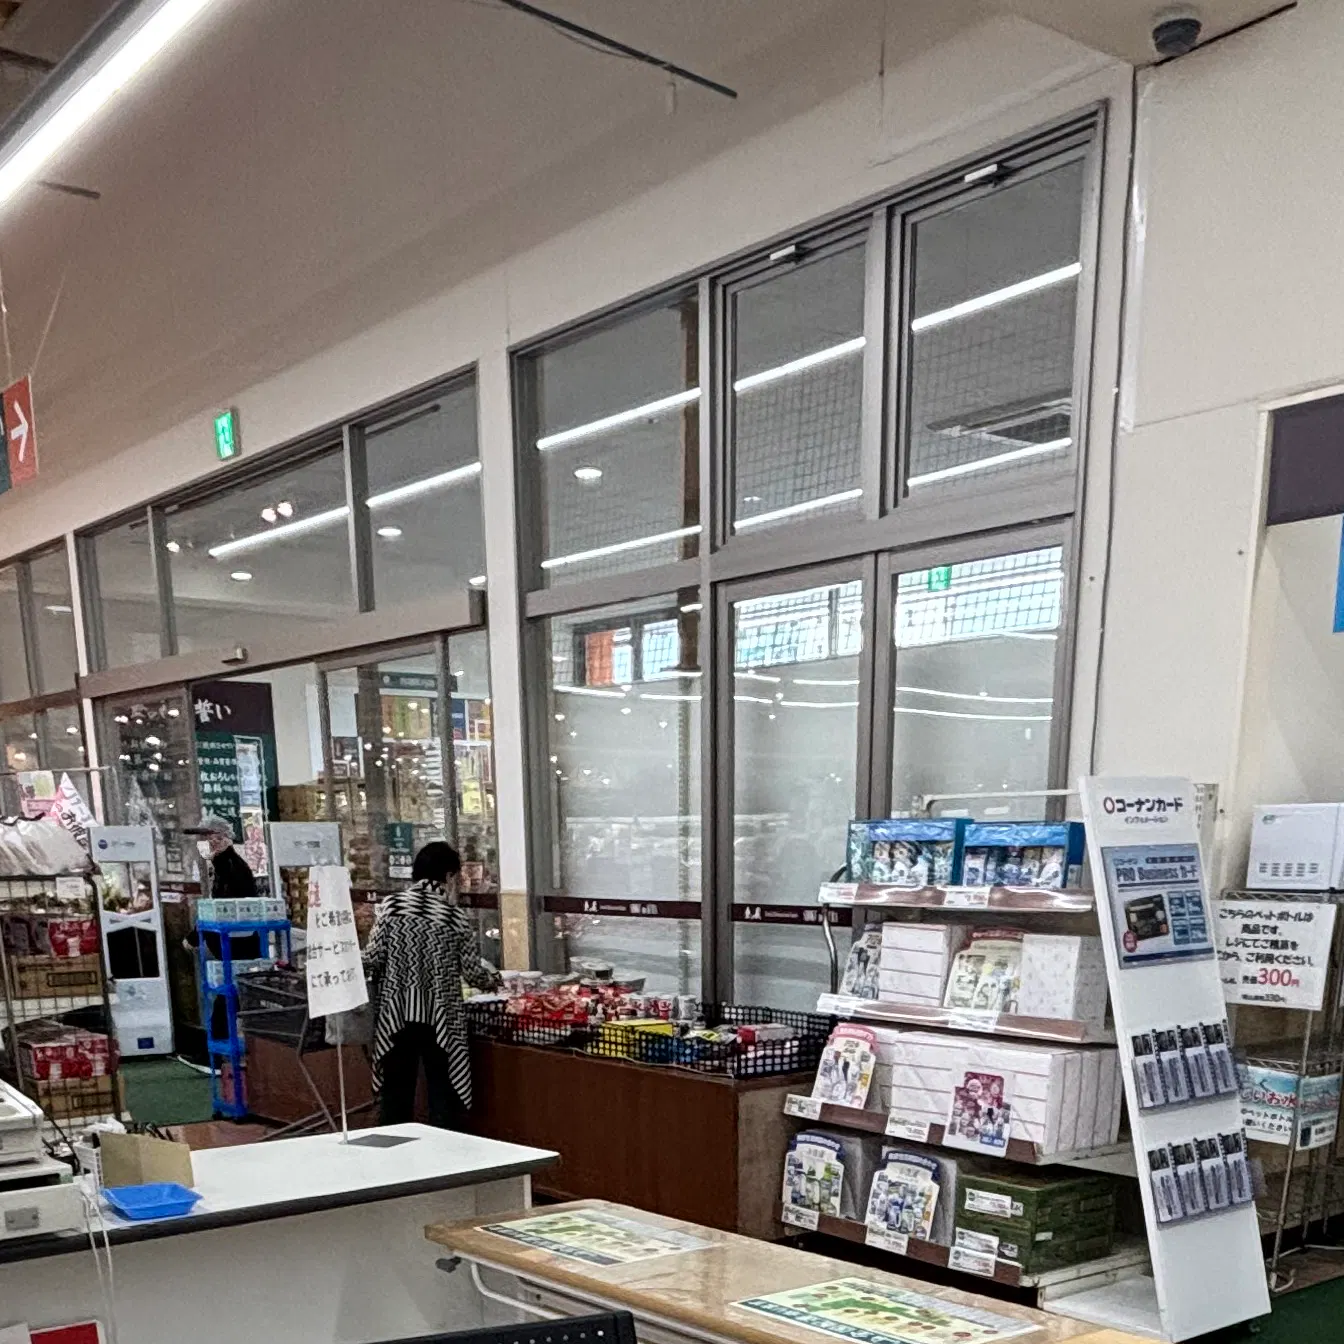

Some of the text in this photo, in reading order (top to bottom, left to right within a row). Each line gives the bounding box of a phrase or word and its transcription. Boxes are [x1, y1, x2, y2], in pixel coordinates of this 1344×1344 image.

[1115, 796, 1184, 813] コーナンカード
